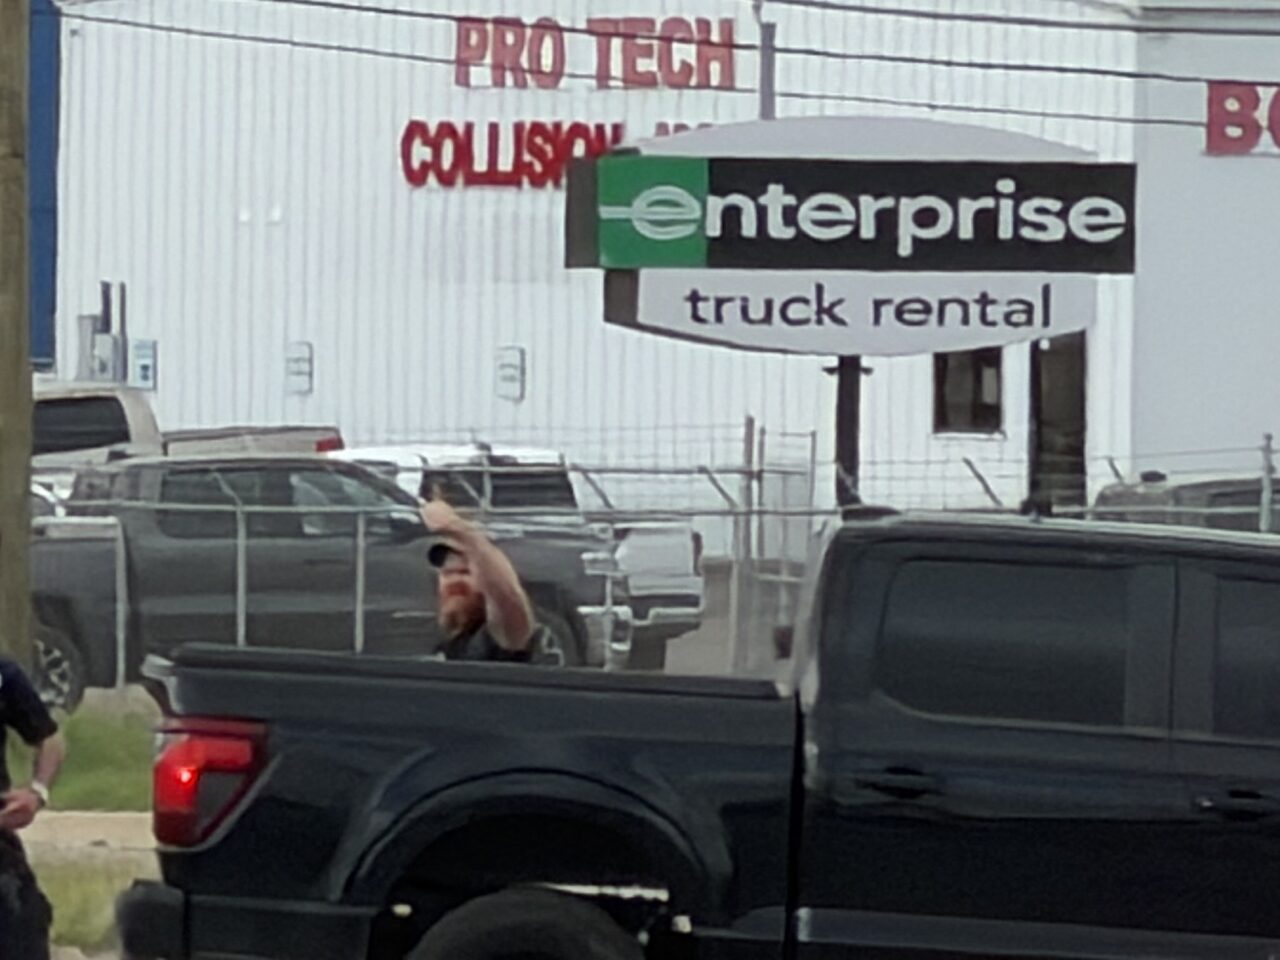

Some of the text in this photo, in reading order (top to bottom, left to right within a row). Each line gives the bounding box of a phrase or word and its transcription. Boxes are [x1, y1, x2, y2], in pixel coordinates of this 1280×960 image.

[455, 16, 735, 89] PRO TECH
[600, 178, 1127, 258] enterprise
[684, 283, 1051, 328] truck rental
